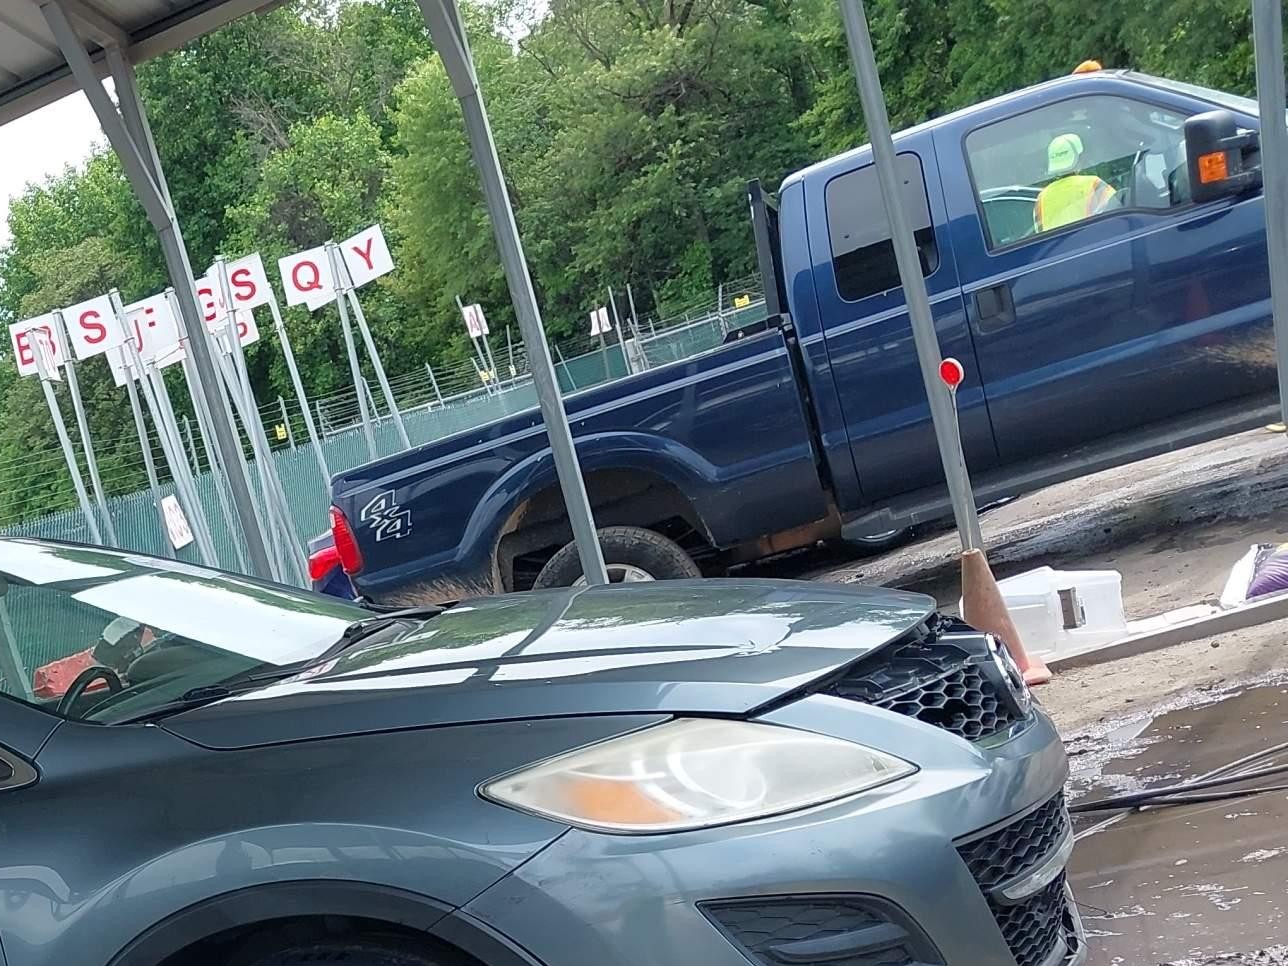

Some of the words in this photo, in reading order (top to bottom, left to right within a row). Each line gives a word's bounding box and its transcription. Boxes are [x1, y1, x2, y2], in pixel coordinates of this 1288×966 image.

[352, 238, 373, 270] Y
[231, 268, 257, 301] S
[291, 261, 323, 292] Q
[79, 310, 107, 344] S
